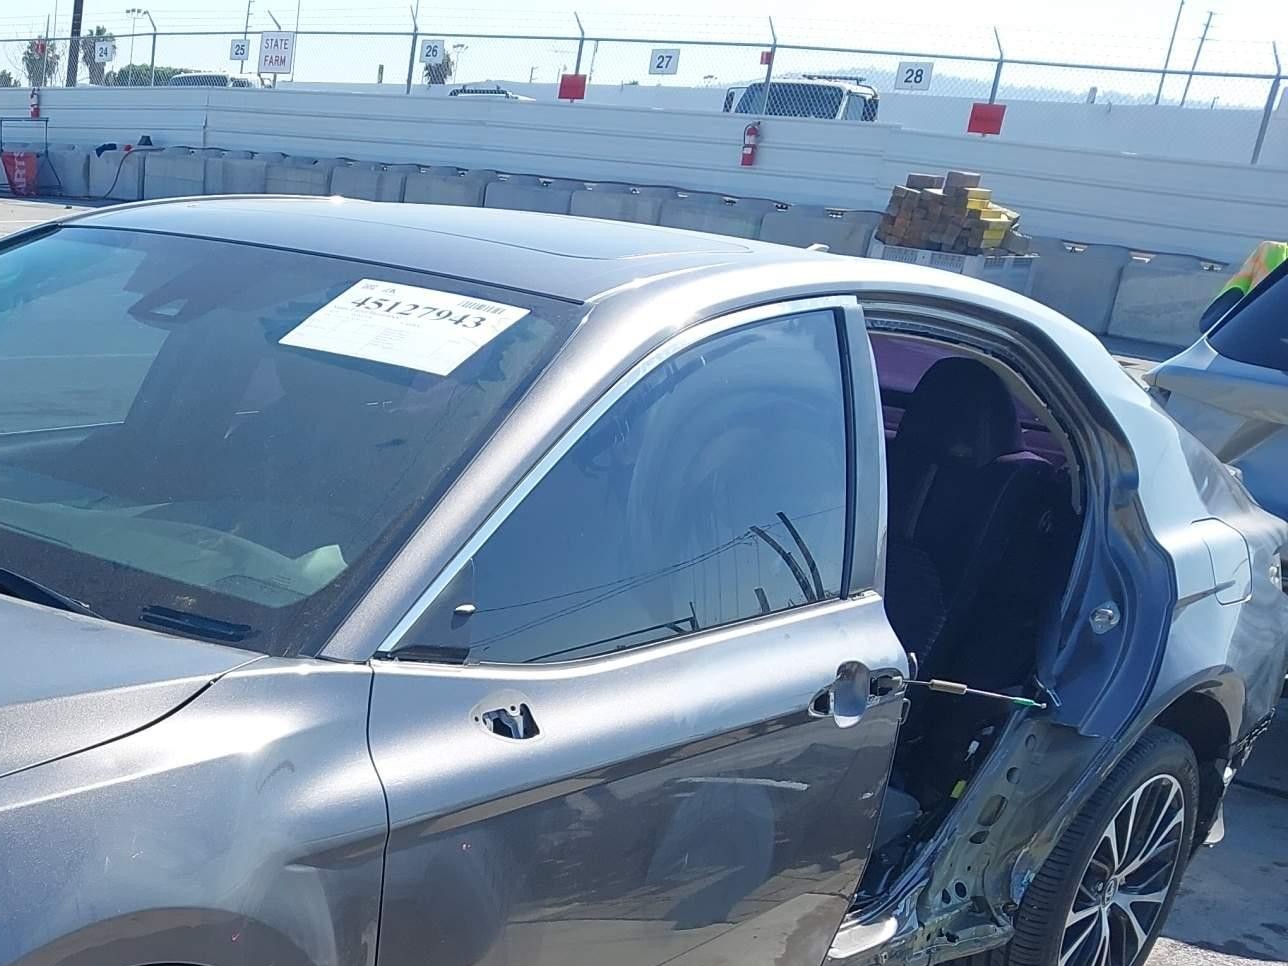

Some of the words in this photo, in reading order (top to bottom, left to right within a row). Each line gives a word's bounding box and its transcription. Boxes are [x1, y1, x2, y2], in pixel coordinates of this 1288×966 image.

[234, 44, 246, 56] 25
[264, 38, 290, 50] STATE
[98, 47, 108, 57] 24
[425, 44, 439, 58] 26
[263, 55, 287, 67] FARM
[656, 55, 673, 69] 27
[904, 68, 924, 84] 28
[351, 296, 487, 329] 45127943
